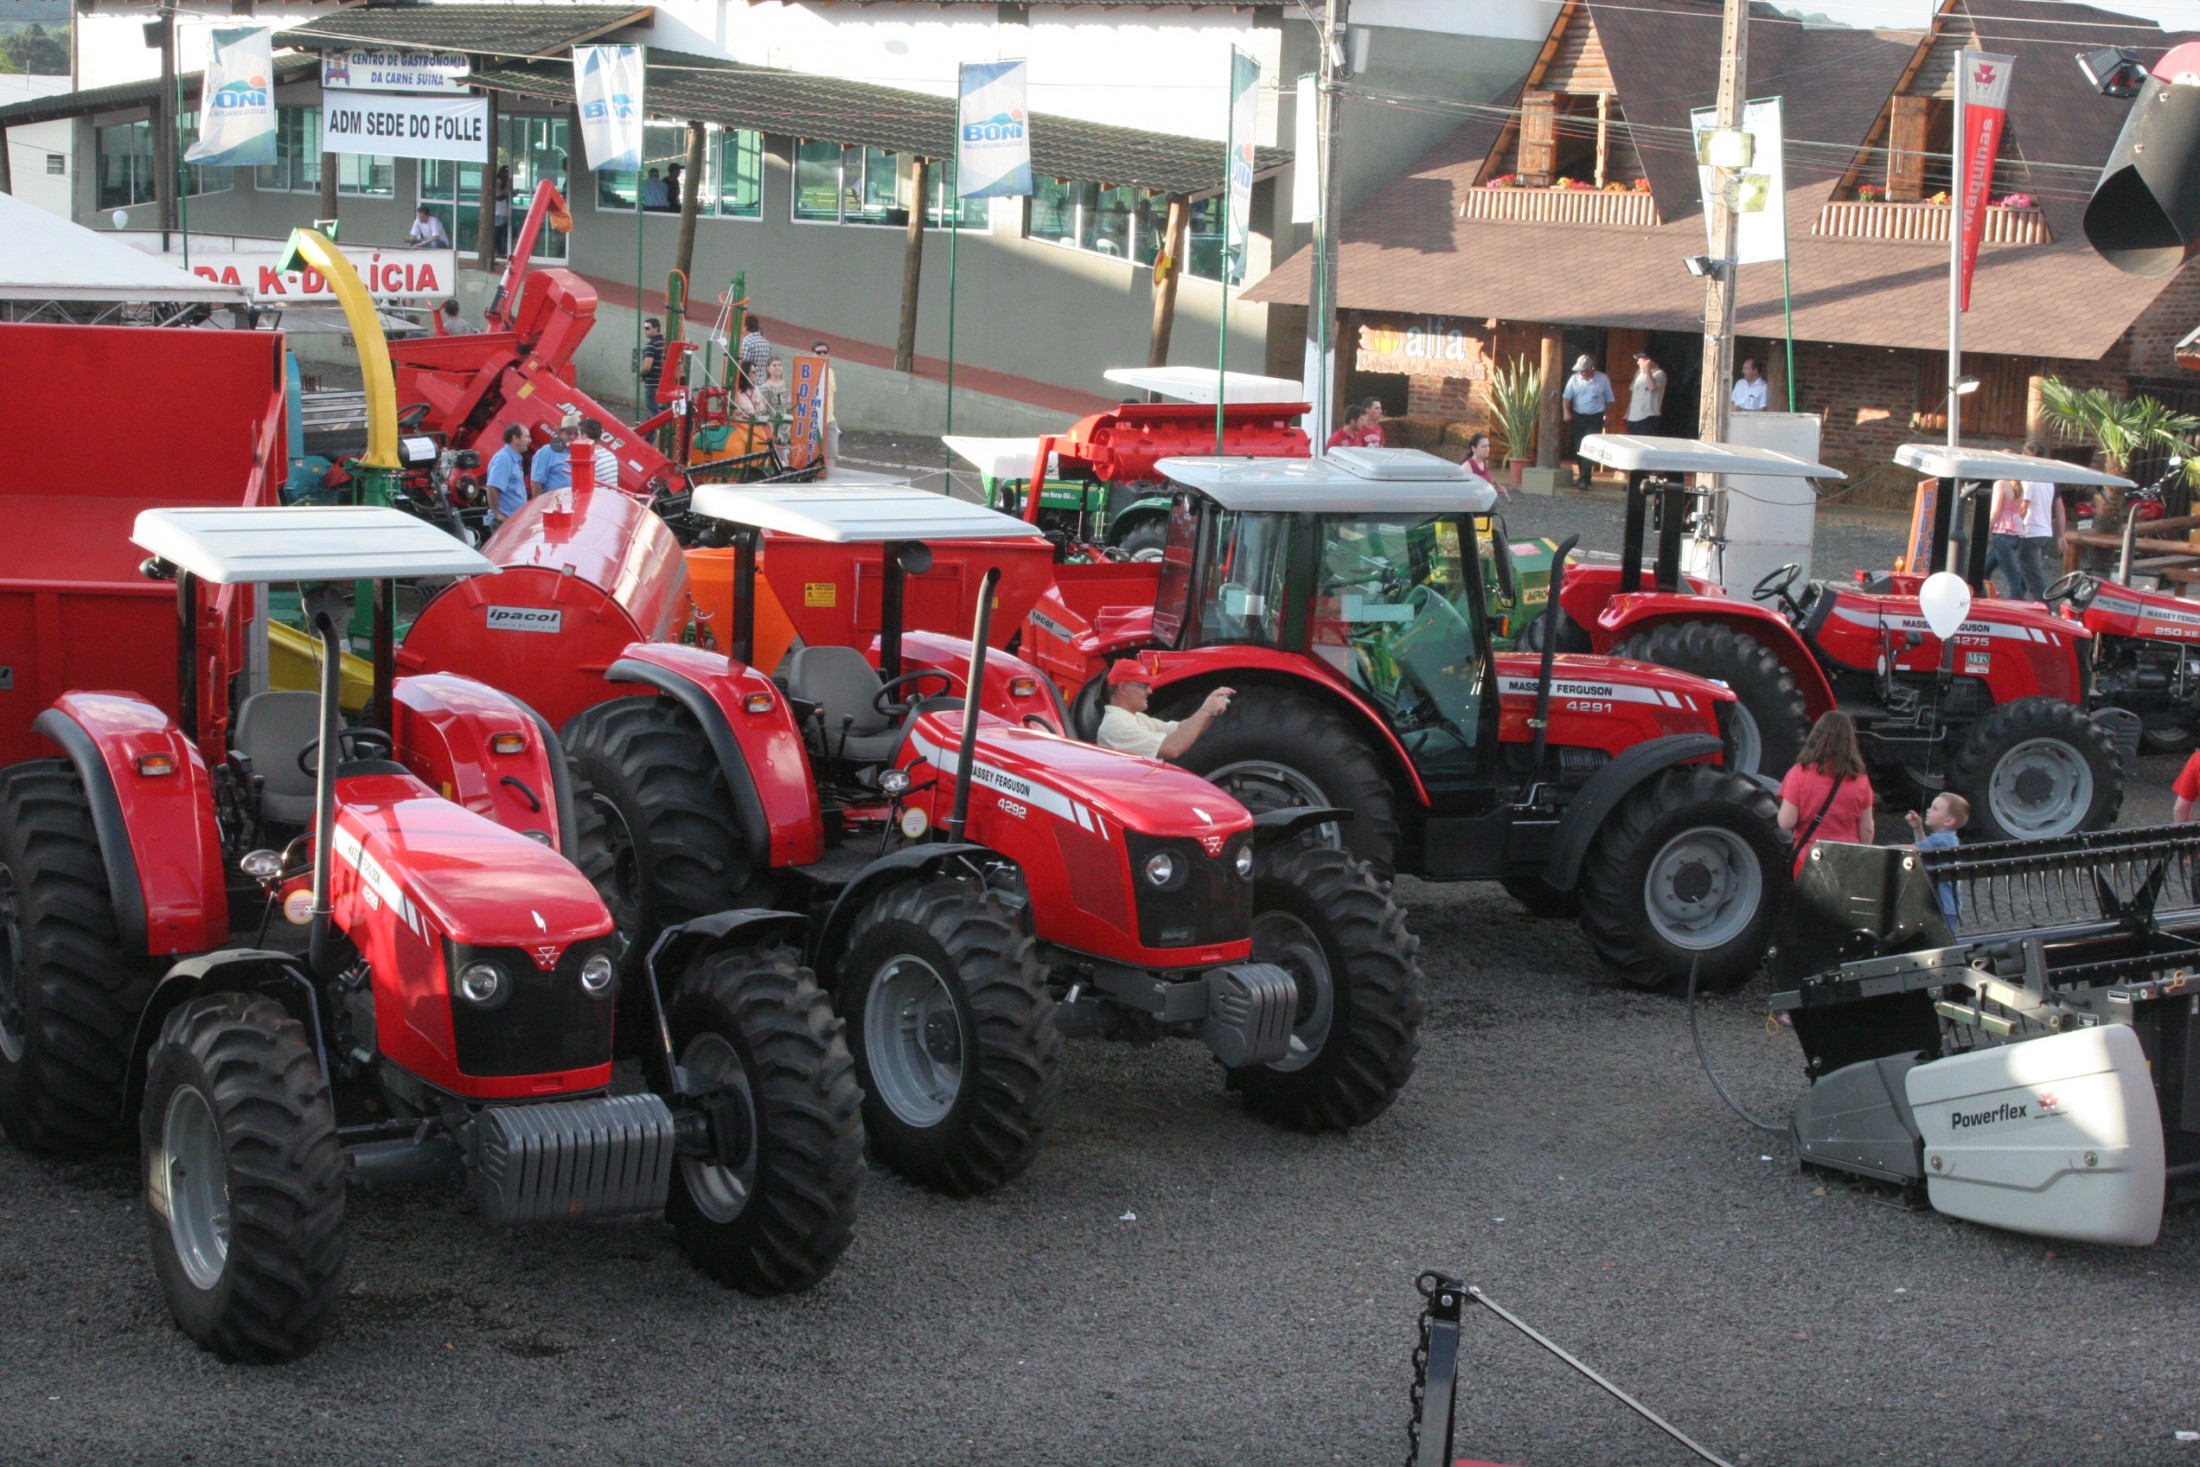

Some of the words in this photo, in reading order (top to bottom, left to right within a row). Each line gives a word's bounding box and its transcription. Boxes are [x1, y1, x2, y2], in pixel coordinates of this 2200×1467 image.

[352, 52, 384, 66] CENTRO
[387, 54, 398, 66] DE
[401, 54, 467, 69] GASTRONOMIA
[371, 72, 383, 84] DA
[385, 72, 413, 85] CARNE
[213, 91, 266, 108] ONI
[583, 104, 634, 118] BON
[329, 109, 362, 134] ADM
[366, 111, 404, 137] SEDE
[409, 114, 430, 139] DO
[435, 115, 482, 142] FOLLE
[963, 125, 1022, 141] BONI
[259, 253, 439, 294] K-DÍCIA
[1405, 316, 1466, 361] alfa
[797, 363, 811, 437] BONI
[489, 608, 558, 623] ipacol
[2147, 610, 2176, 620] MASSEY
[1902, 619, 1932, 629] MASS
[1957, 623, 1991, 633] GUSON
[2155, 626, 2182, 637] 250
[1508, 681, 1550, 693] MASS
[1556, 684, 1613, 696] FERGUSON
[1566, 701, 1613, 713] 4291
[971, 765, 994, 784] ASSEY
[995, 774, 1031, 797] FERGUSON
[997, 798, 1027, 820] 4292
[1951, 1103, 2028, 1130] Powerflex
